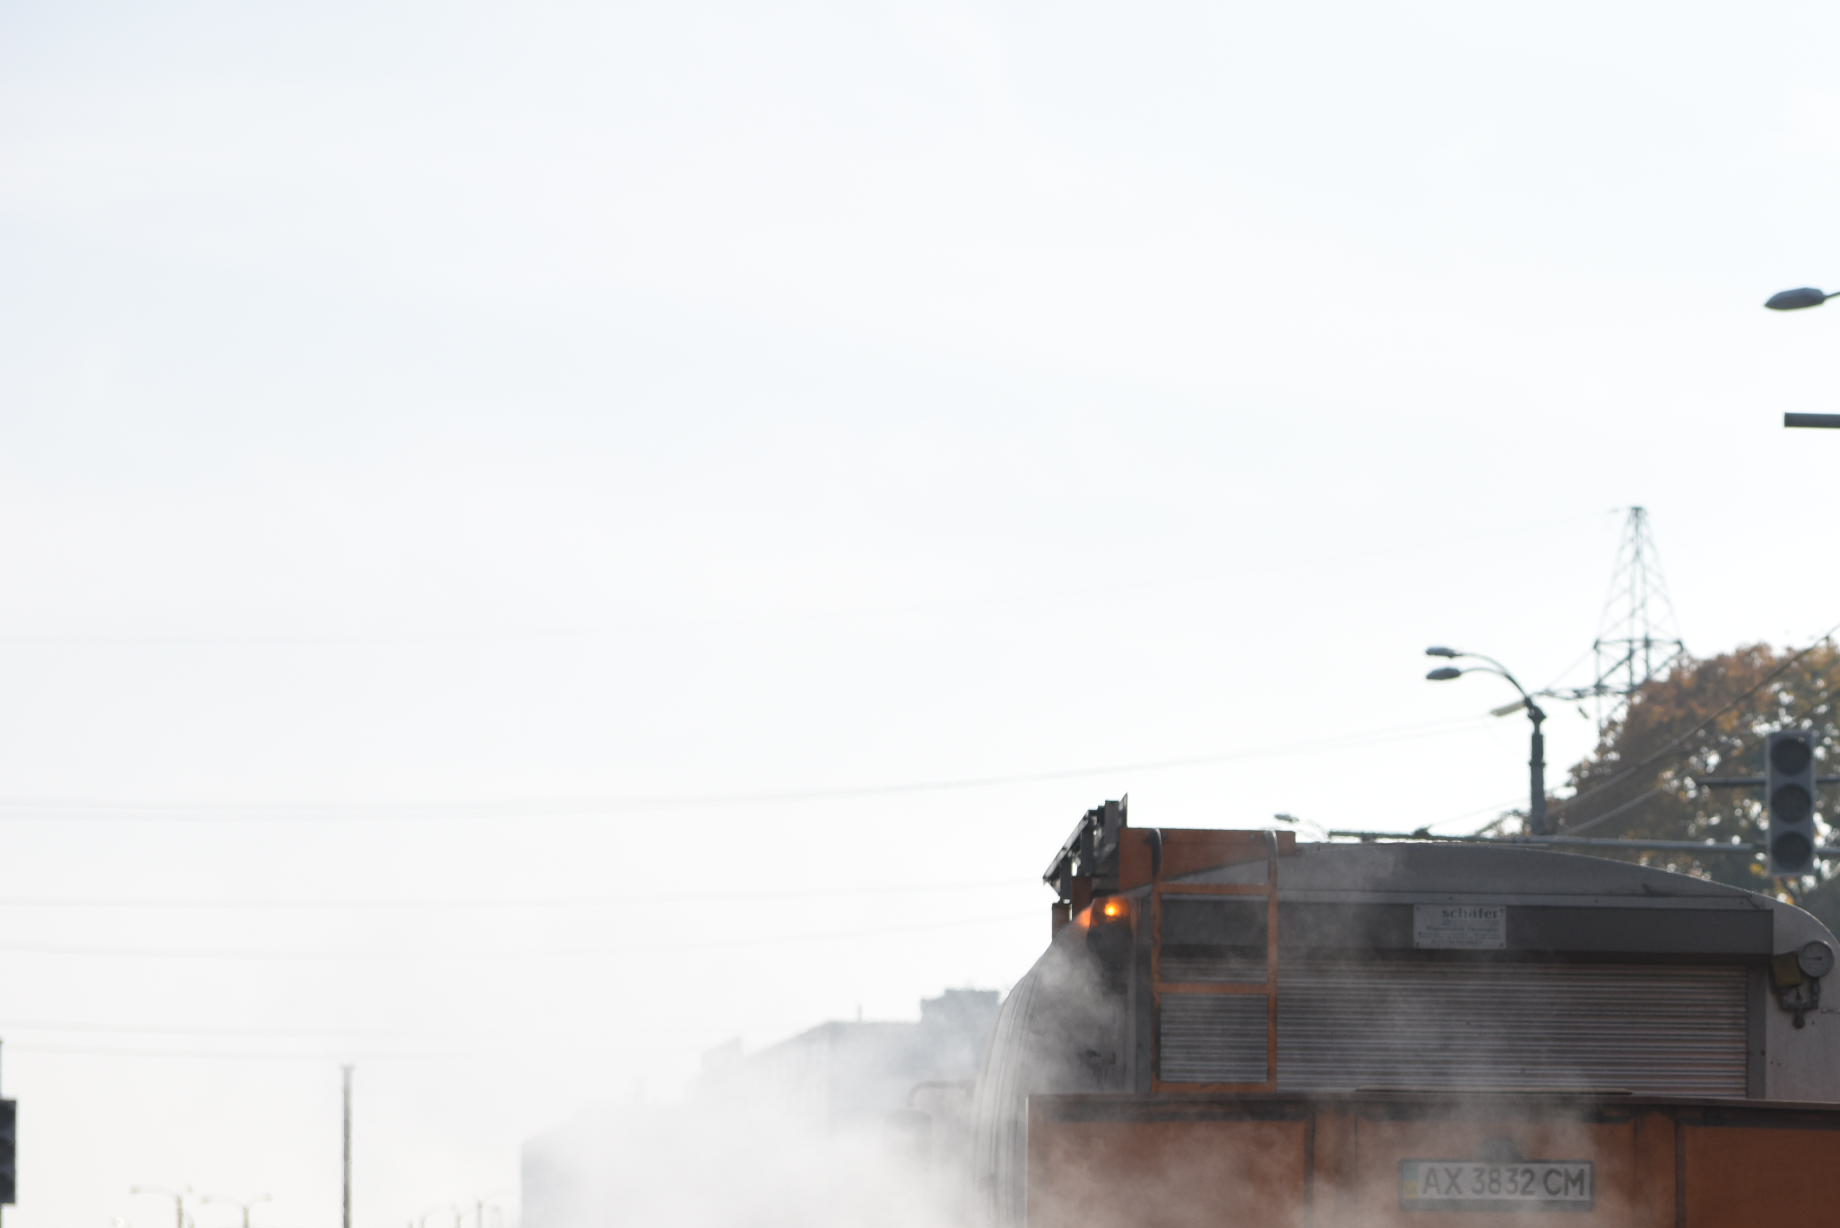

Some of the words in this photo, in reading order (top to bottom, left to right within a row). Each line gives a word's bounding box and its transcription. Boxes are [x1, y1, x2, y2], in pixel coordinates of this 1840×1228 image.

[1421, 1167, 1463, 1195] AX
[1471, 1167, 1536, 1196] 3832
[1543, 1168, 1586, 1196] CM
